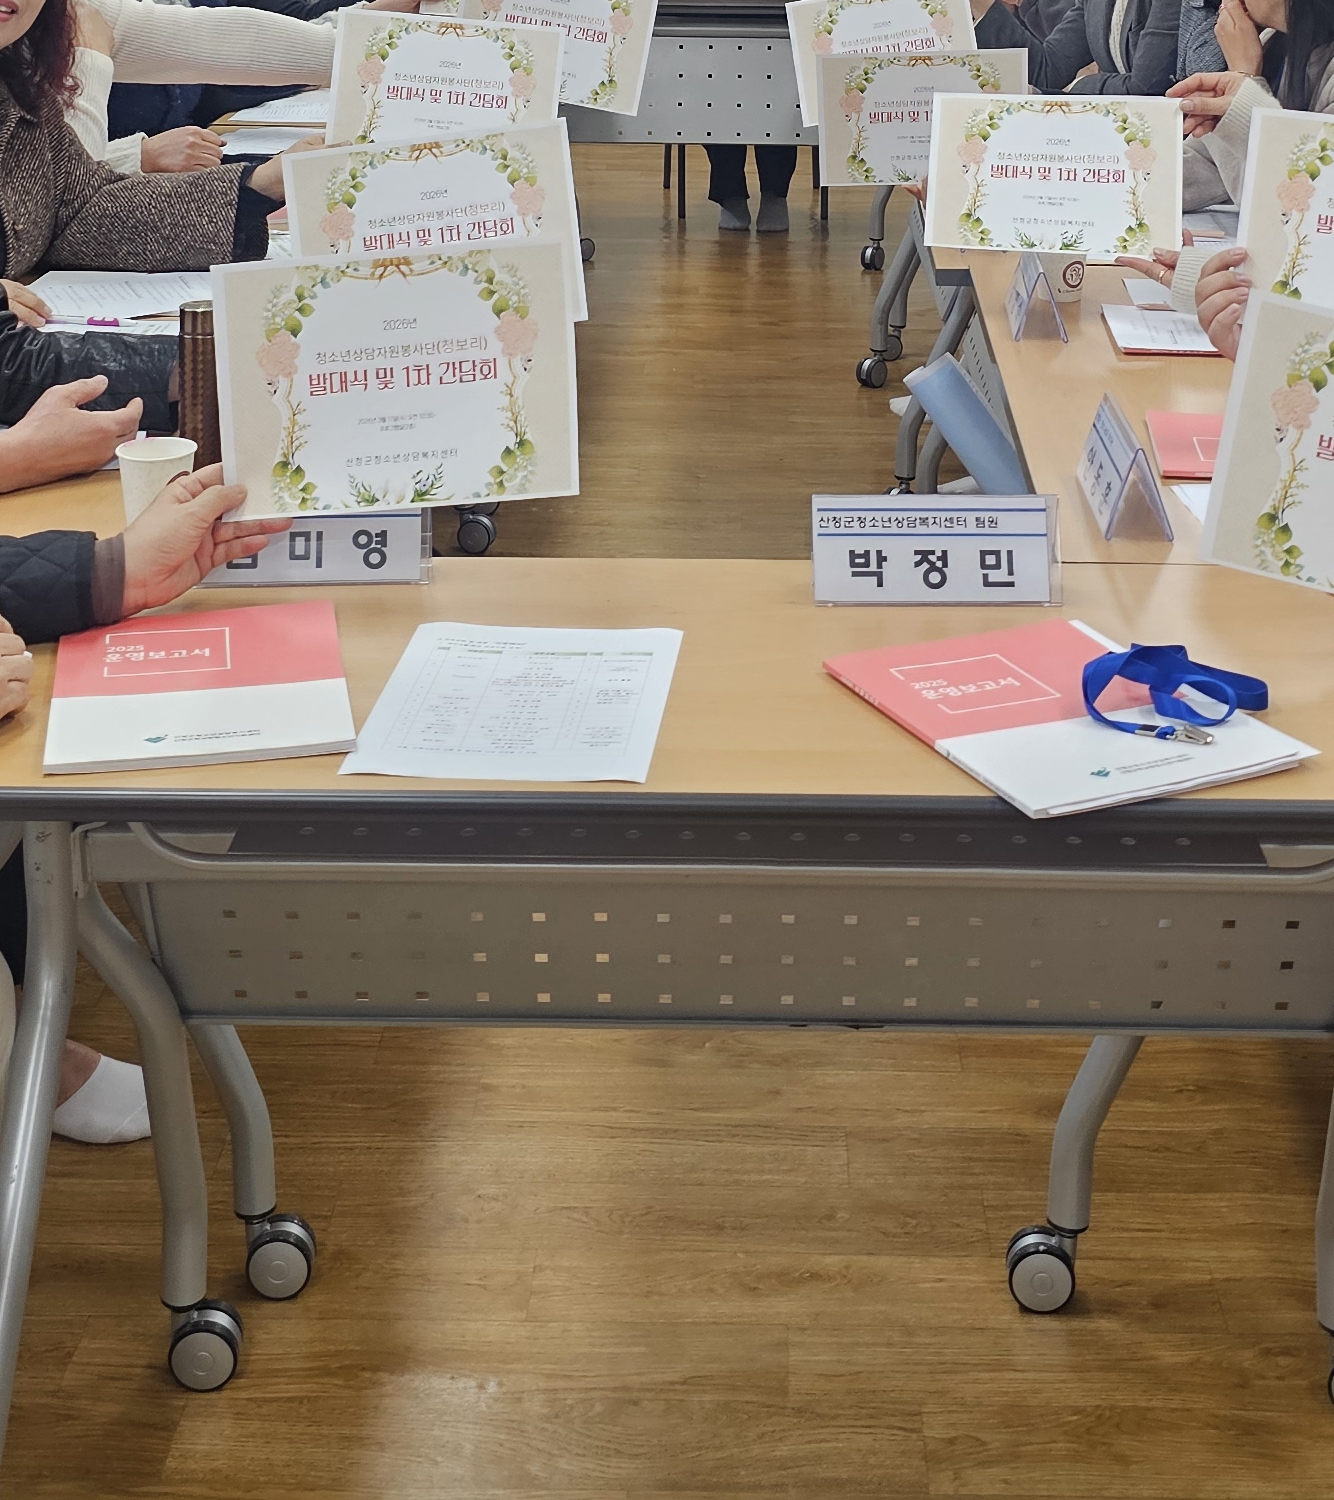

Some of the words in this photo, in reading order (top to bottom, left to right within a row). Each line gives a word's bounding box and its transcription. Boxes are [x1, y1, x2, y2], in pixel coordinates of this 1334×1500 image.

[573, 26, 608, 44] 간담회
[386, 84, 425, 102] 발대식
[429, 88, 442, 105] 및
[447, 89, 466, 106] 1차
[469, 91, 509, 110] 간담회
[869, 110, 904, 124] 발대식
[908, 110, 920, 123] 및
[990, 164, 1033, 180] 발대식
[1037, 166, 1051, 181] 및
[1057, 167, 1078, 182] 1차
[1082, 168, 1126, 184] 간담회
[363, 231, 411, 251] 발대식
[416, 228, 433, 246] 및
[436, 225, 462, 244] 1차
[466, 217, 515, 241] 간담회
[383, 318, 417, 331] 2026년
[315, 336, 488, 365] 청소년상담자원봉사단(청보리)
[308, 368, 368, 397] 발대식
[375, 366, 396, 390] 및
[401, 363, 433, 388] 1차
[438, 357, 498, 385] 간담회
[818, 515, 968, 529] 산청군청소년상담복지센터
[975, 516, 999, 529] 팀원
[103, 648, 211, 662] 운영보고서
[106, 644, 145, 653] 2025
[910, 679, 948, 689] 2025
[921, 677, 1021, 699] 운영보고서
